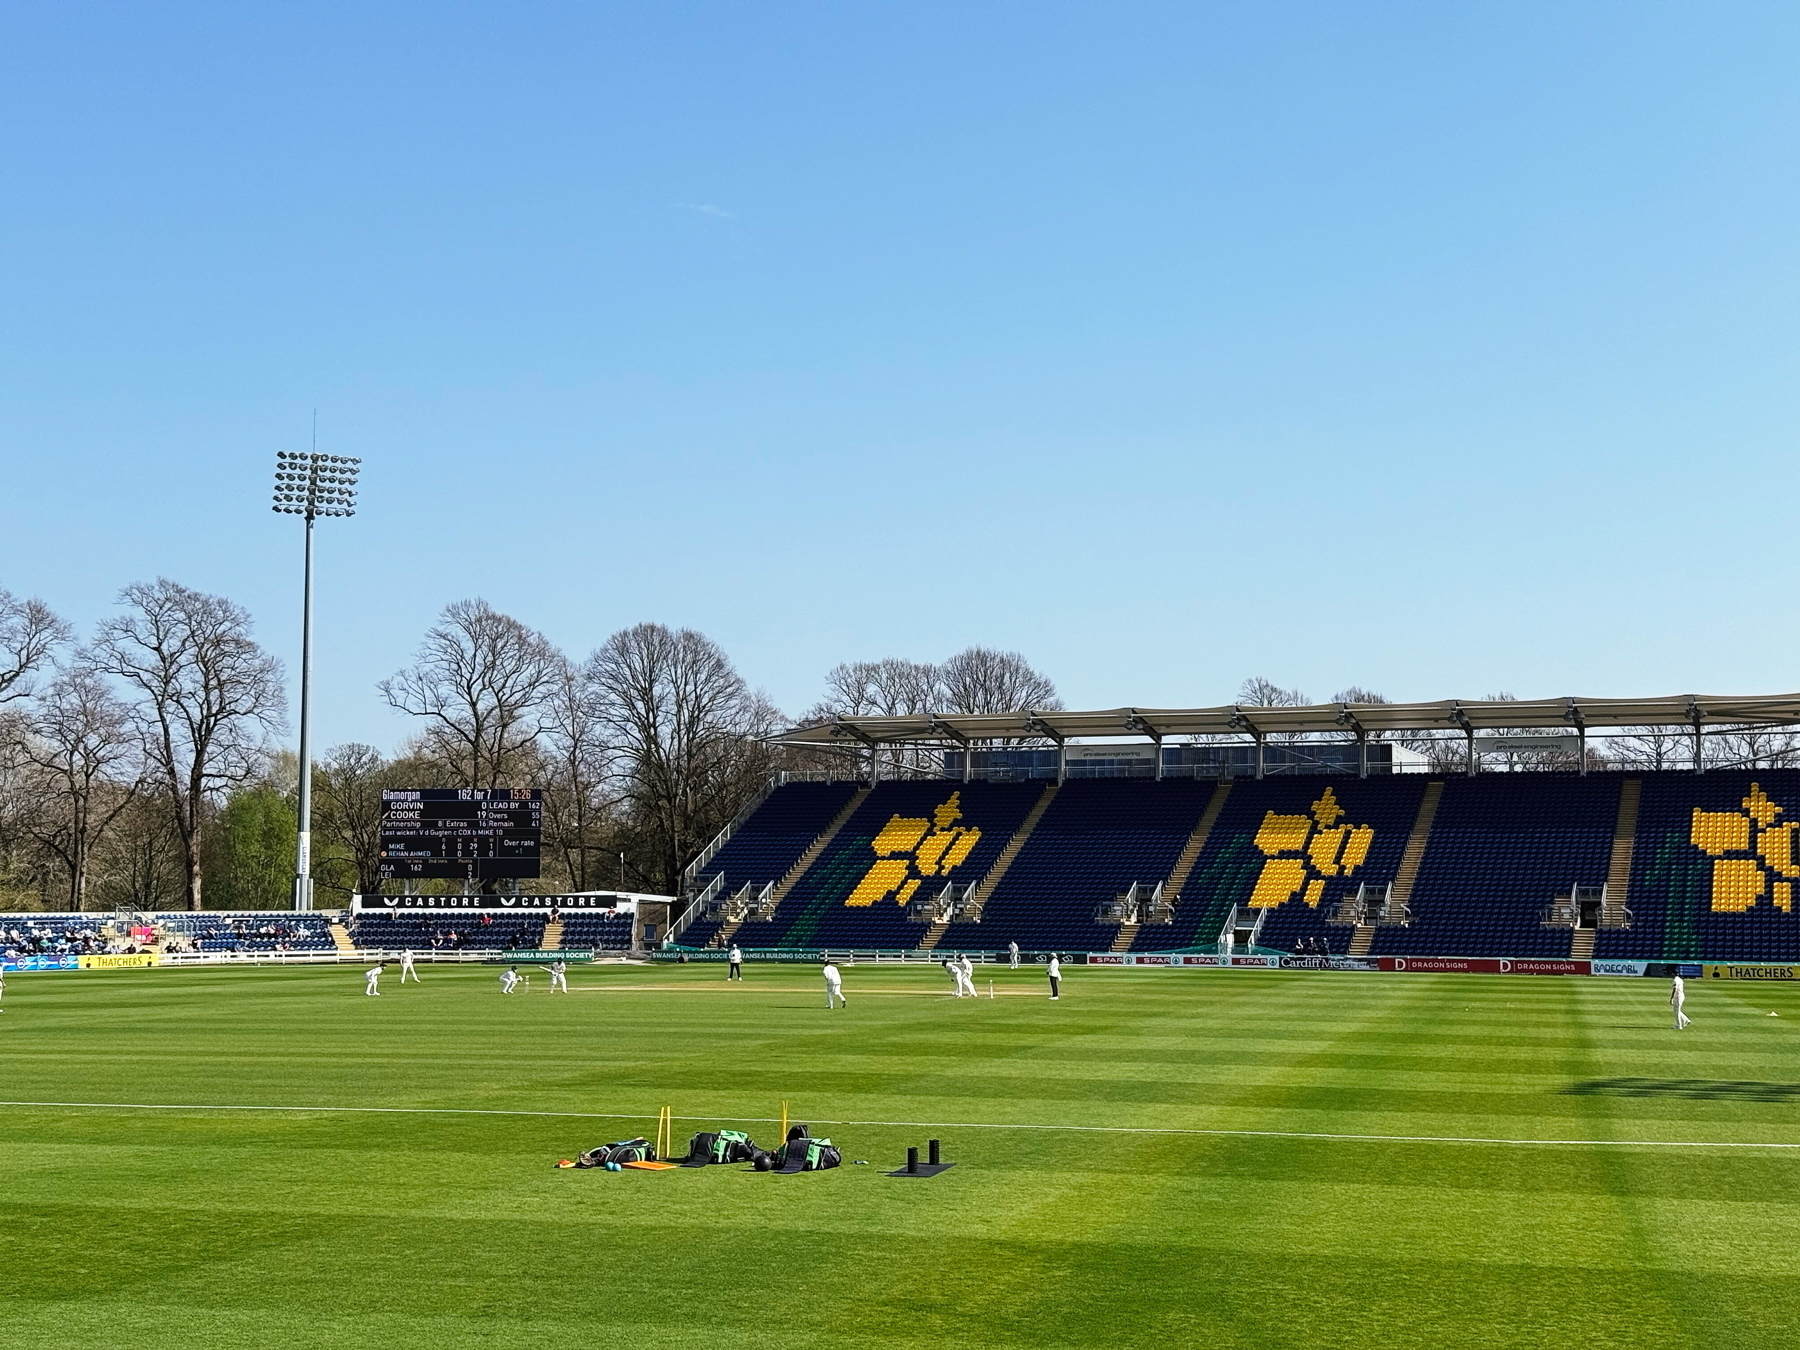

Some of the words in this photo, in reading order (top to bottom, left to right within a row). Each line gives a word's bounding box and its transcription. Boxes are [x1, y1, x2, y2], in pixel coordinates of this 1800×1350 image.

[382, 790, 420, 801] Glamorgan
[458, 790, 471, 800] 162
[474, 790, 484, 800] for
[487, 790, 491, 800] 7
[510, 790, 531, 800] 15:26
[391, 802, 423, 810] GORVIN
[481, 802, 486, 810] 0
[390, 811, 420, 819] COOKE
[477, 811, 486, 819] 19
[405, 897, 479, 906] CASTORE
[522, 897, 596, 906] CASTORE
[97, 956, 142, 967] THATCHERS
[1281, 958, 1321, 968] Cardiff
[1727, 965, 1794, 978] THATCHERS
